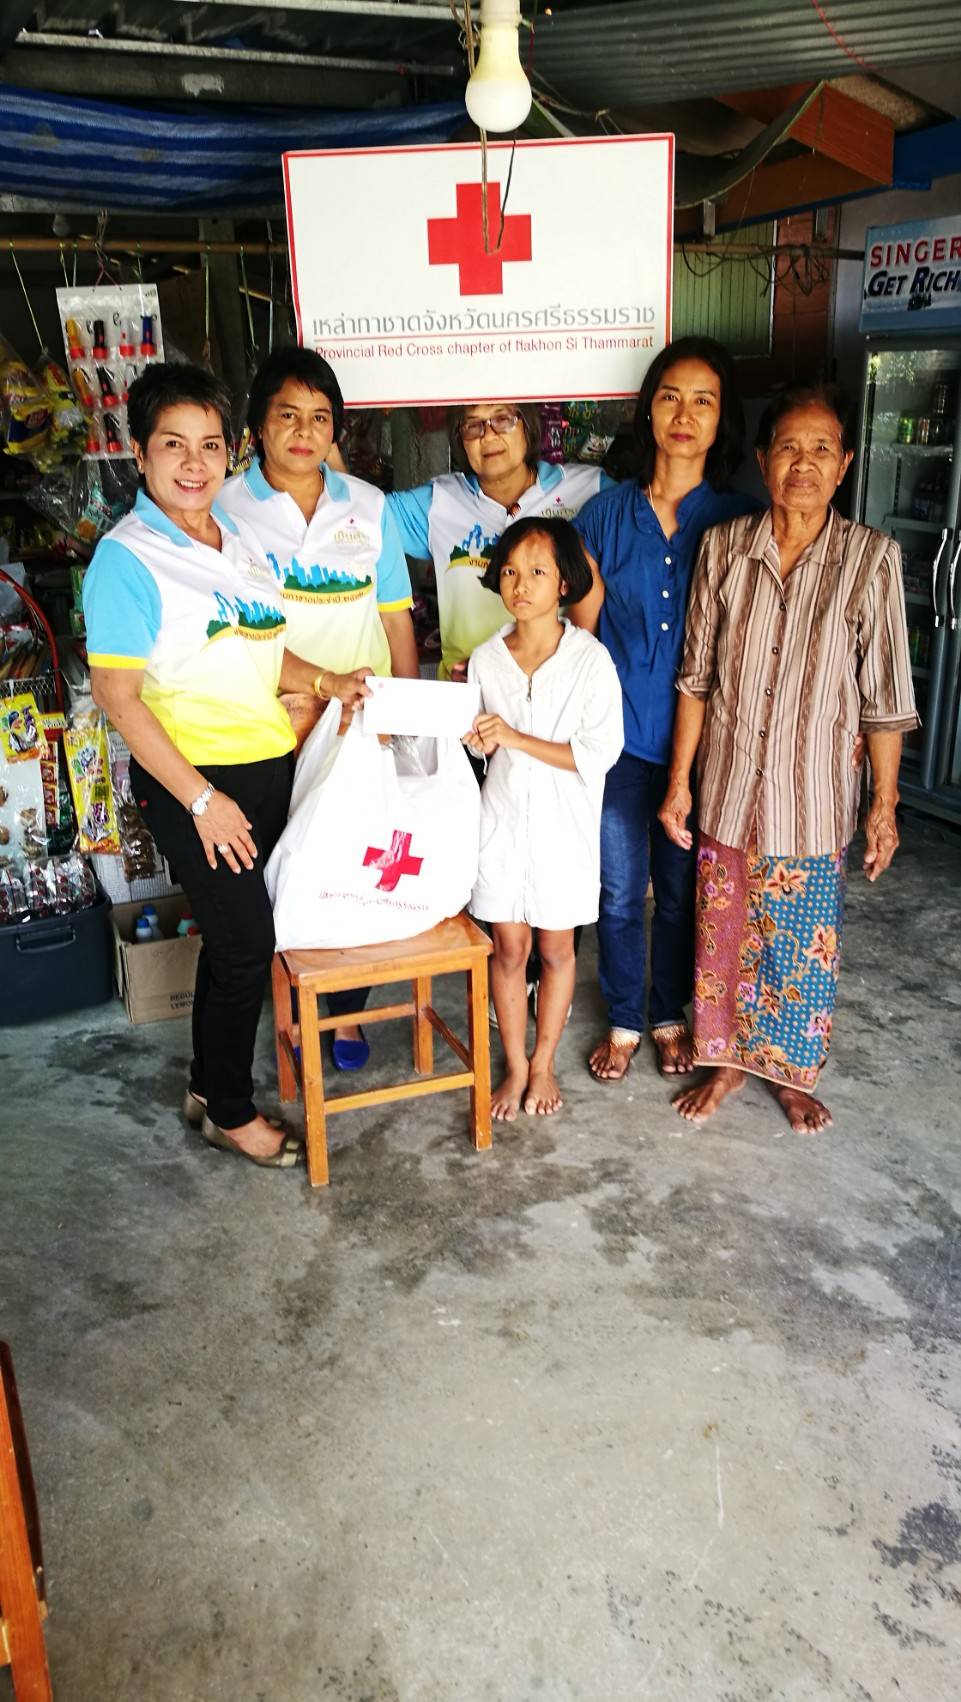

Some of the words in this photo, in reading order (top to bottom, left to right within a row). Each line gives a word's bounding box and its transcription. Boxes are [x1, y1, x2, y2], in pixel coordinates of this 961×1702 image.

[869, 236, 961, 267] SINGER
[868, 269, 908, 297] GET
[313, 303, 655, 336] เหล่ากาชาดจังหวัดนครศรีธรรมราช
[314, 345, 375, 361] Provincial
[378, 343, 403, 358] Red
[407, 342, 444, 357] Cross
[446, 339, 496, 356] chapter
[499, 339, 512, 353] of
[516, 337, 563, 352] Nakhon
[566, 336, 579, 350] Si
[582, 334, 654, 350] Thammarat
